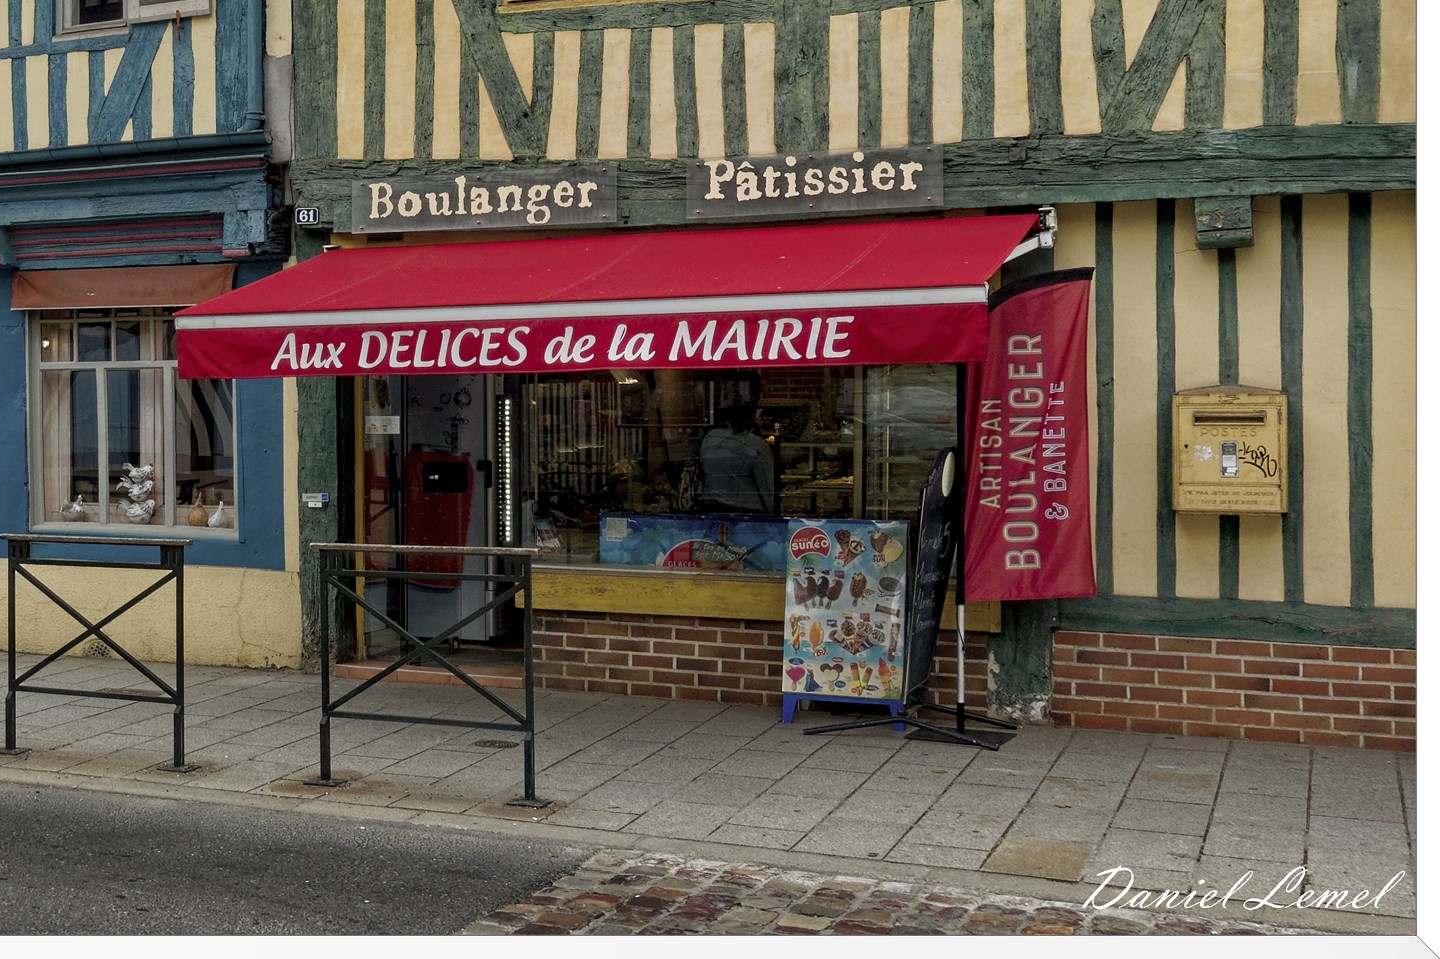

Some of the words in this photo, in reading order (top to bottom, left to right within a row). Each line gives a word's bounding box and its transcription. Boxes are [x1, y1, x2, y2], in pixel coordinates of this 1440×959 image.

[300, 210, 314, 222] 61
[368, 176, 598, 224] Boulanger
[703, 151, 923, 202] Pâtissier
[270, 332, 346, 370] Aux
[358, 326, 531, 369] DELICES
[544, 326, 596, 364] de
[607, 323, 656, 362] la
[668, 315, 855, 361] MAIRIE
[979, 398, 1002, 509] ARTISAN
[1002, 334, 1044, 570] BOULANGER
[1042, 381, 1068, 492] BANETTE
[1200, 427, 1257, 437] POSTES
[1044, 502, 1069, 520] &
